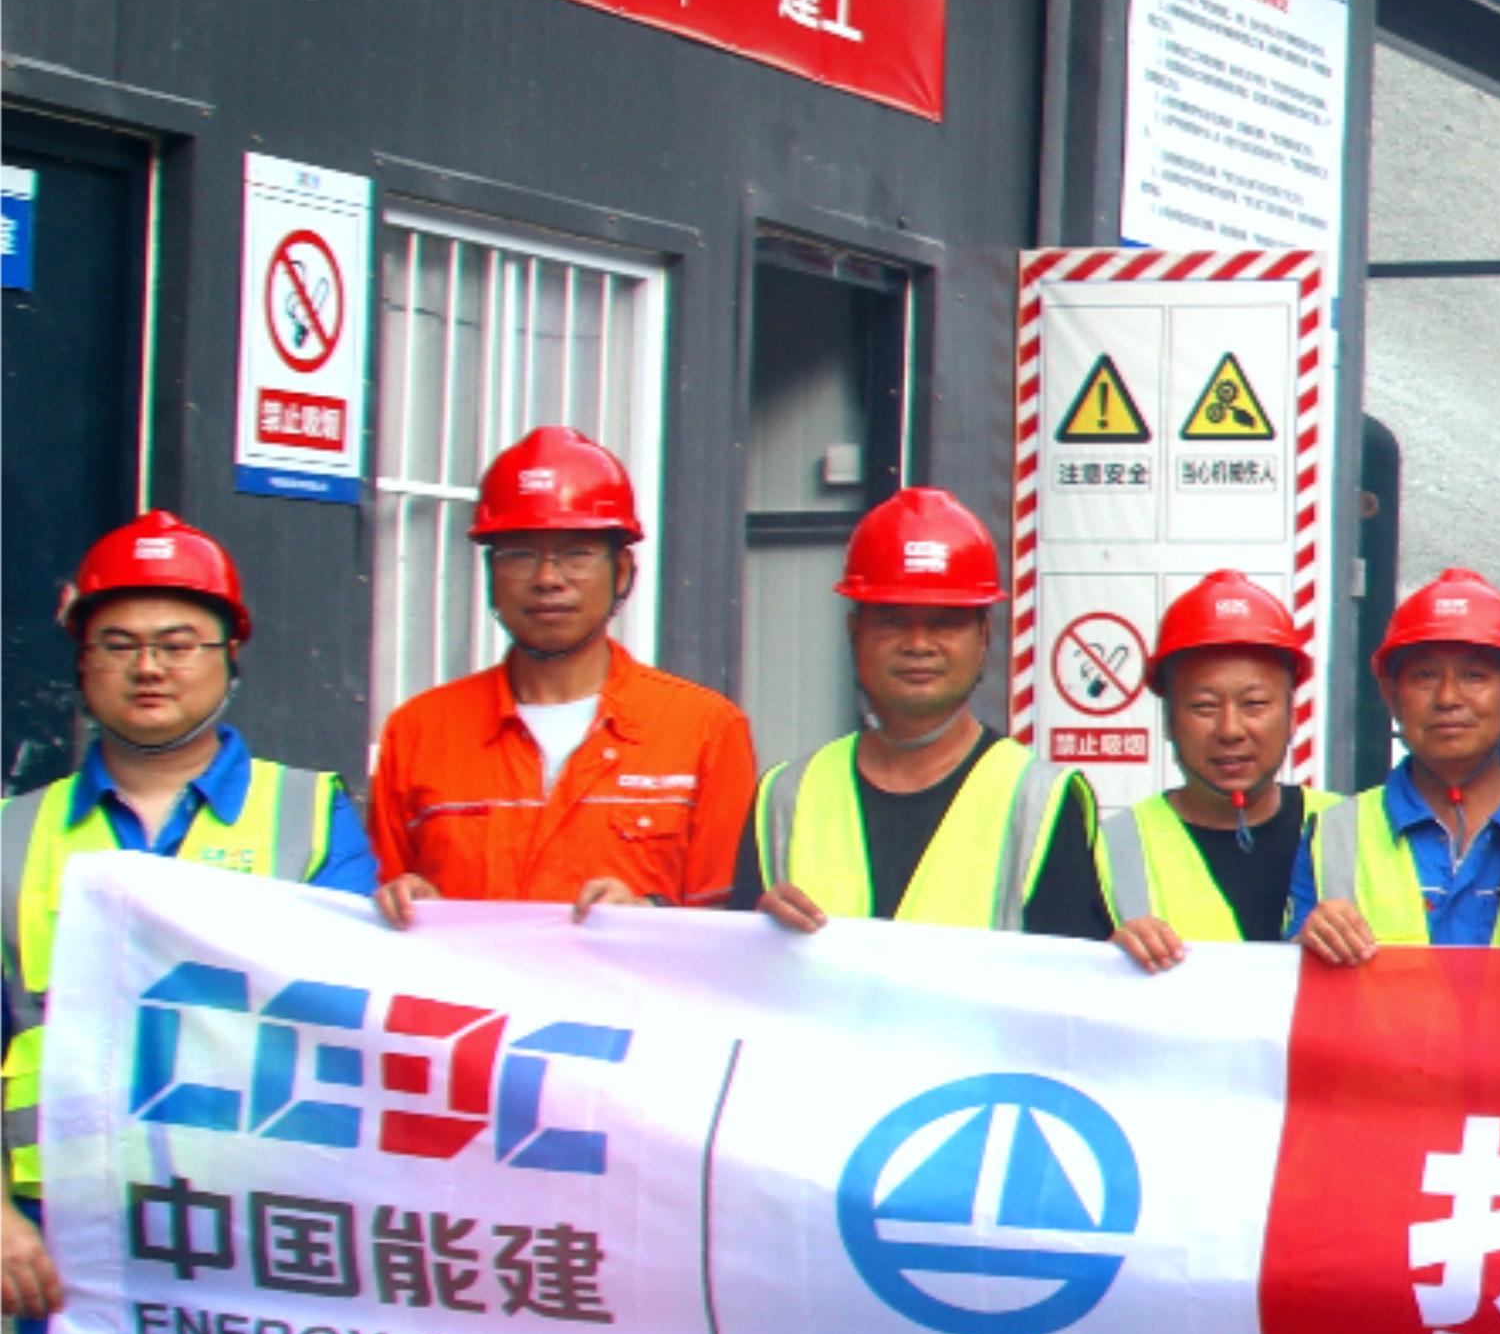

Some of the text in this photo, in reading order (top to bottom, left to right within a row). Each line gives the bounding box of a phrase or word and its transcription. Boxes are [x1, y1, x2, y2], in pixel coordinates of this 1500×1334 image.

[1058, 463, 1149, 487] 注意安全
[1180, 461, 1275, 486] 当心机械伤人
[1054, 733, 1147, 757] 禁止吸烟
[124, 1174, 616, 1329] 中国能建
